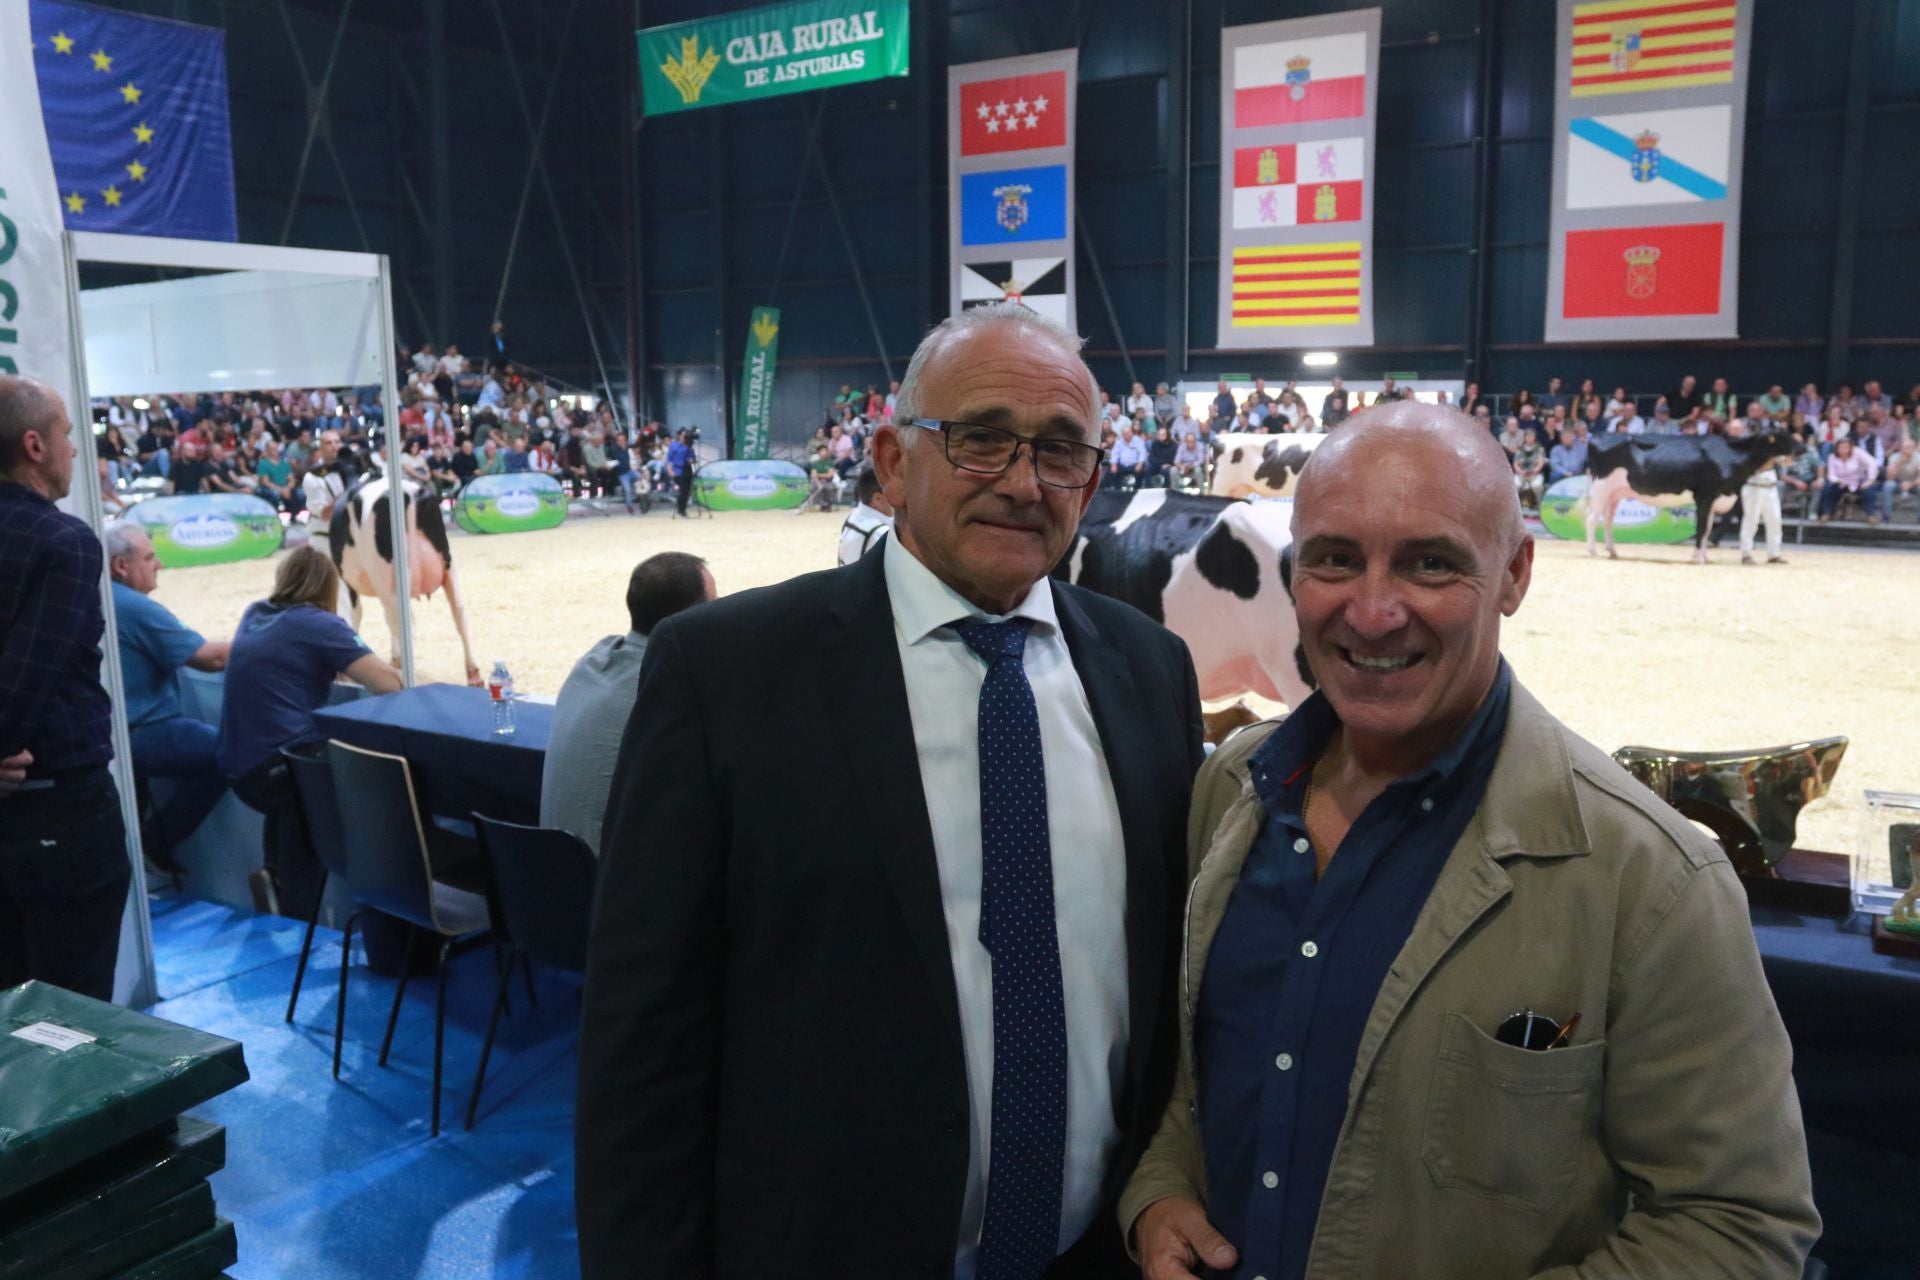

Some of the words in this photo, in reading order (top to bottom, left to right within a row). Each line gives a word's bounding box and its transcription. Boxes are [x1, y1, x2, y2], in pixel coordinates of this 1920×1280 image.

[726, 30, 788, 65] CAJA
[792, 10, 884, 53] RURAL
[744, 67, 769, 88] DE
[773, 49, 865, 83] ASTURIAS
[746, 351, 766, 418] RURAL
[743, 421, 759, 459] AJA
